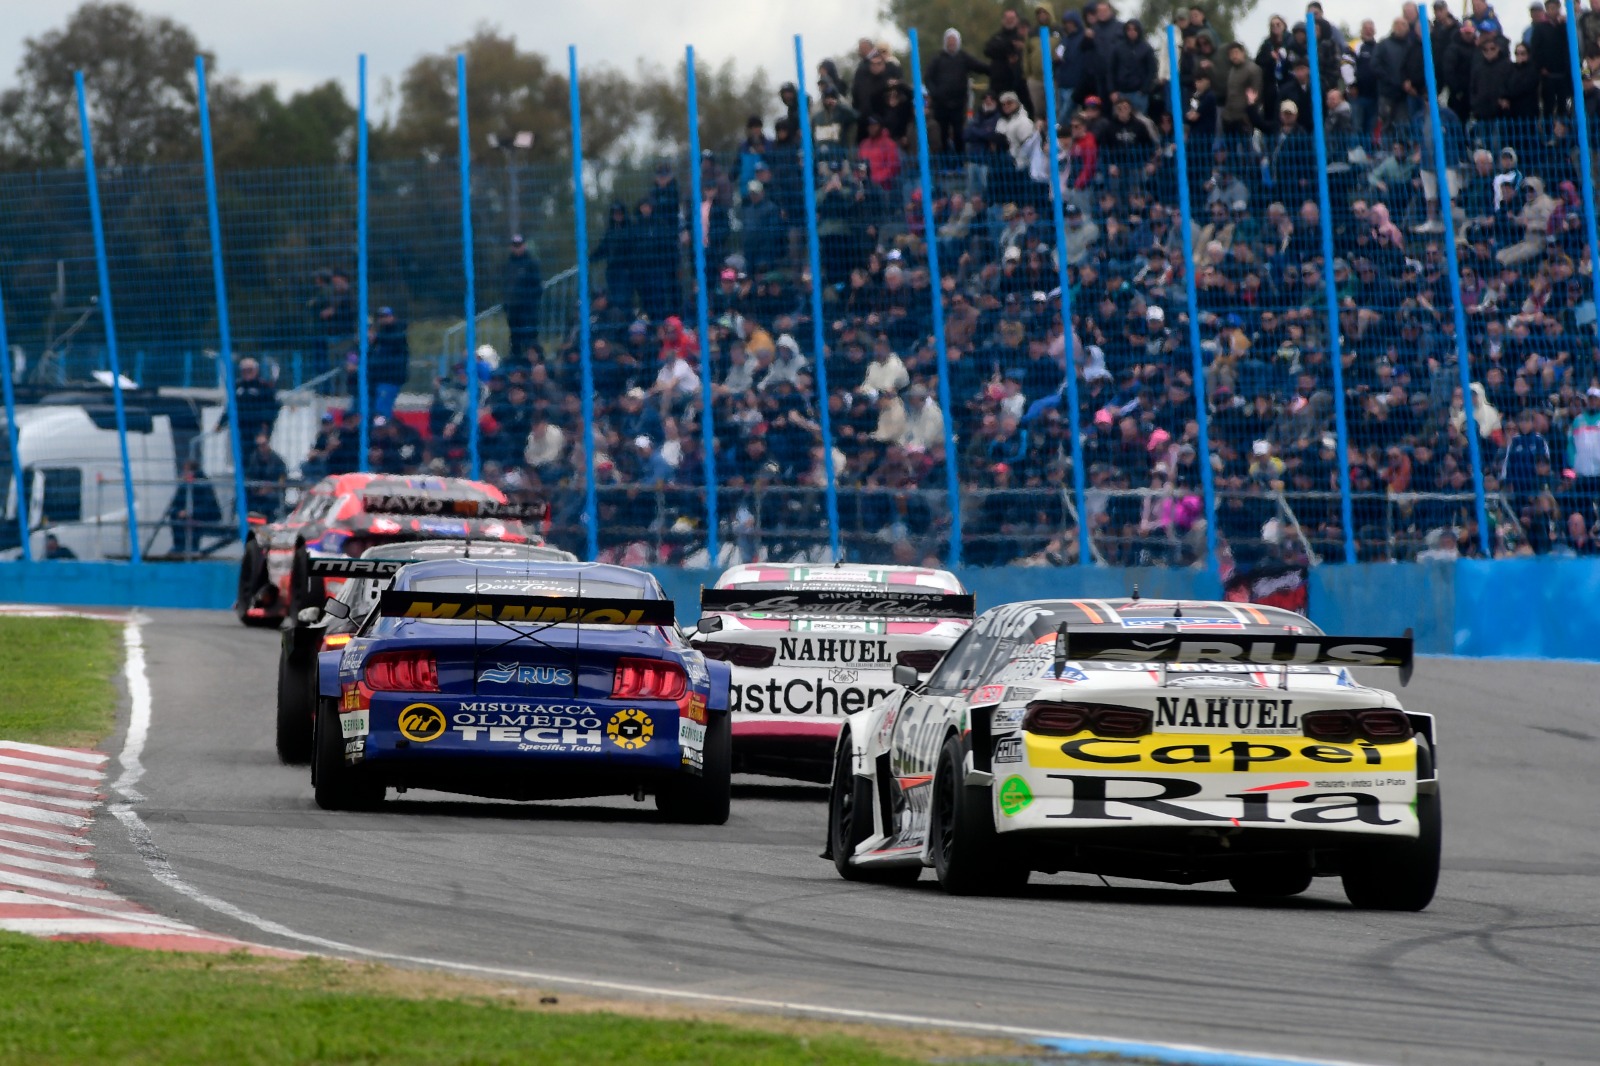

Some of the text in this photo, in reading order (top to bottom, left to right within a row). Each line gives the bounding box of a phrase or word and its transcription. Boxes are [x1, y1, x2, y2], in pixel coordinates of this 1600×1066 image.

[818, 592, 943, 602] PINTURERIAS
[402, 601, 646, 625] MANNOL
[779, 637, 892, 663] NAHUEL
[1176, 641, 1389, 665] RUS
[517, 666, 573, 686] RUS
[459, 702, 596, 715] MISURACCA
[1155, 696, 1299, 730] NAHUEL
[452, 713, 602, 729] OLMEDO
[452, 725, 602, 745] TECH
[517, 743, 602, 753] Specific Tools
[1375, 779, 1385, 787] La
[1386, 778, 1407, 787] Plata
